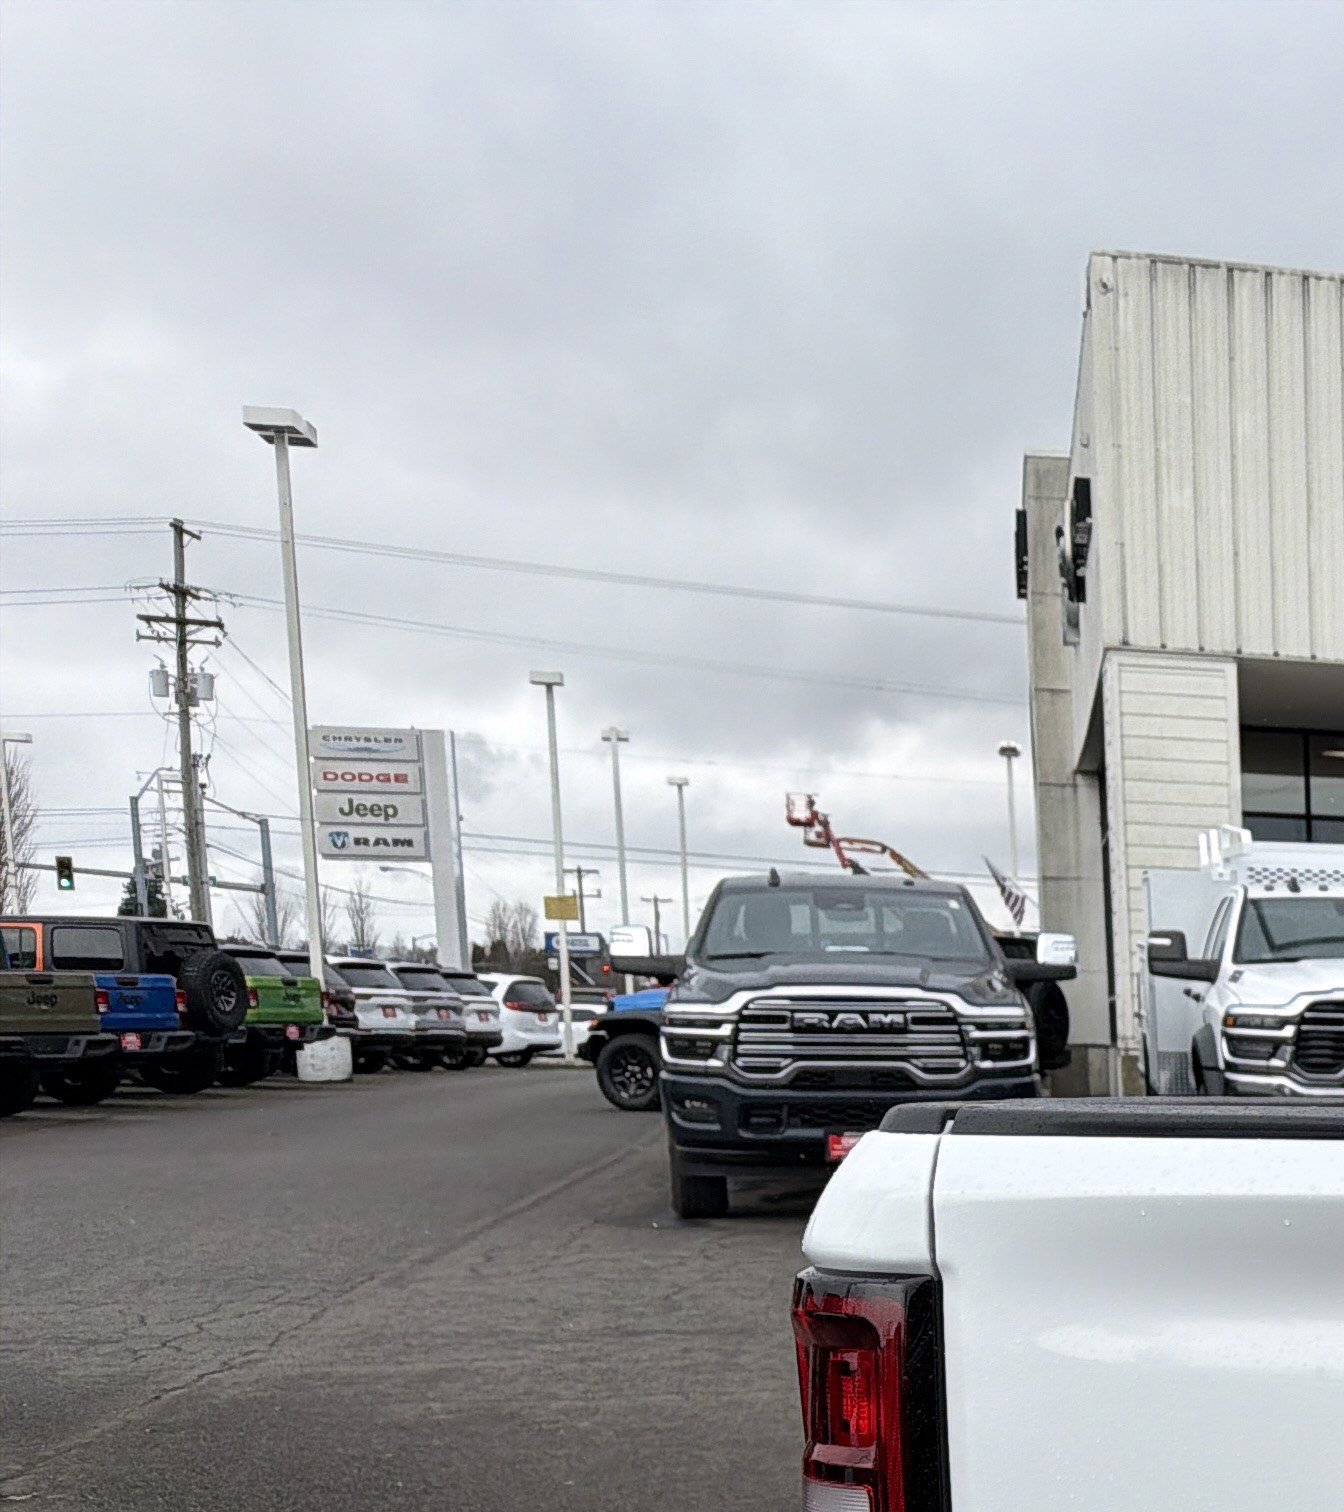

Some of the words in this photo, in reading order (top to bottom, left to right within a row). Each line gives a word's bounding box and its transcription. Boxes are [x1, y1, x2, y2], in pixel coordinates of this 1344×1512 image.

[321, 735, 404, 744] CHRYSLER
[322, 770, 409, 784] DODGE
[338, 797, 399, 821] Jeep
[352, 836, 414, 848] RAM
[792, 1012, 906, 1030] RAM
